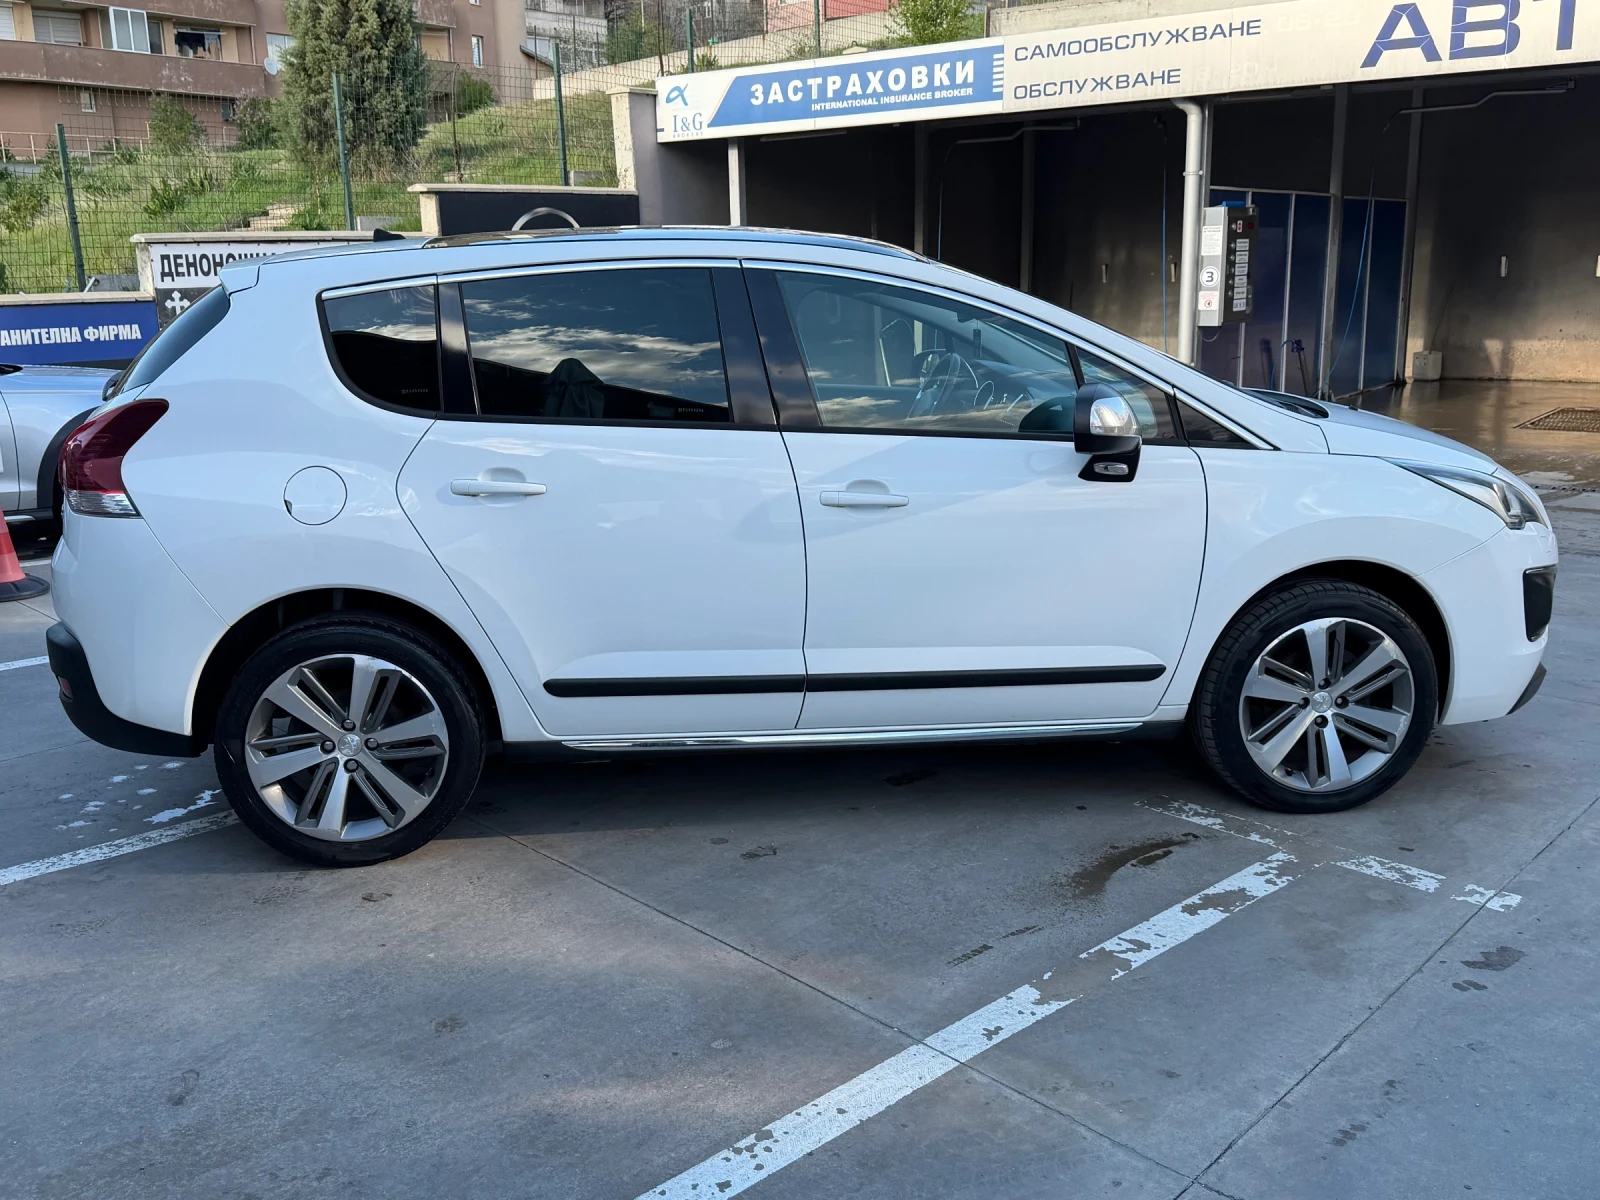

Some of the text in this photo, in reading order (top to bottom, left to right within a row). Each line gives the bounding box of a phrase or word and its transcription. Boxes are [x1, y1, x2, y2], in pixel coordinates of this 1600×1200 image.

[1014, 19, 1262, 61] САМООБСЛУЖВАНЕ
[750, 59, 975, 106] ЗАСТРАХОВКИ
[1013, 69, 1182, 100] ОБСЛУЖВАНЕ
[811, 88, 973, 111] INTERNATIONAL INSURANCE BROKER
[672, 112, 704, 133] I&G
[1205, 271, 1215, 283] 3
[83, 324, 142, 342] ФИРМА
